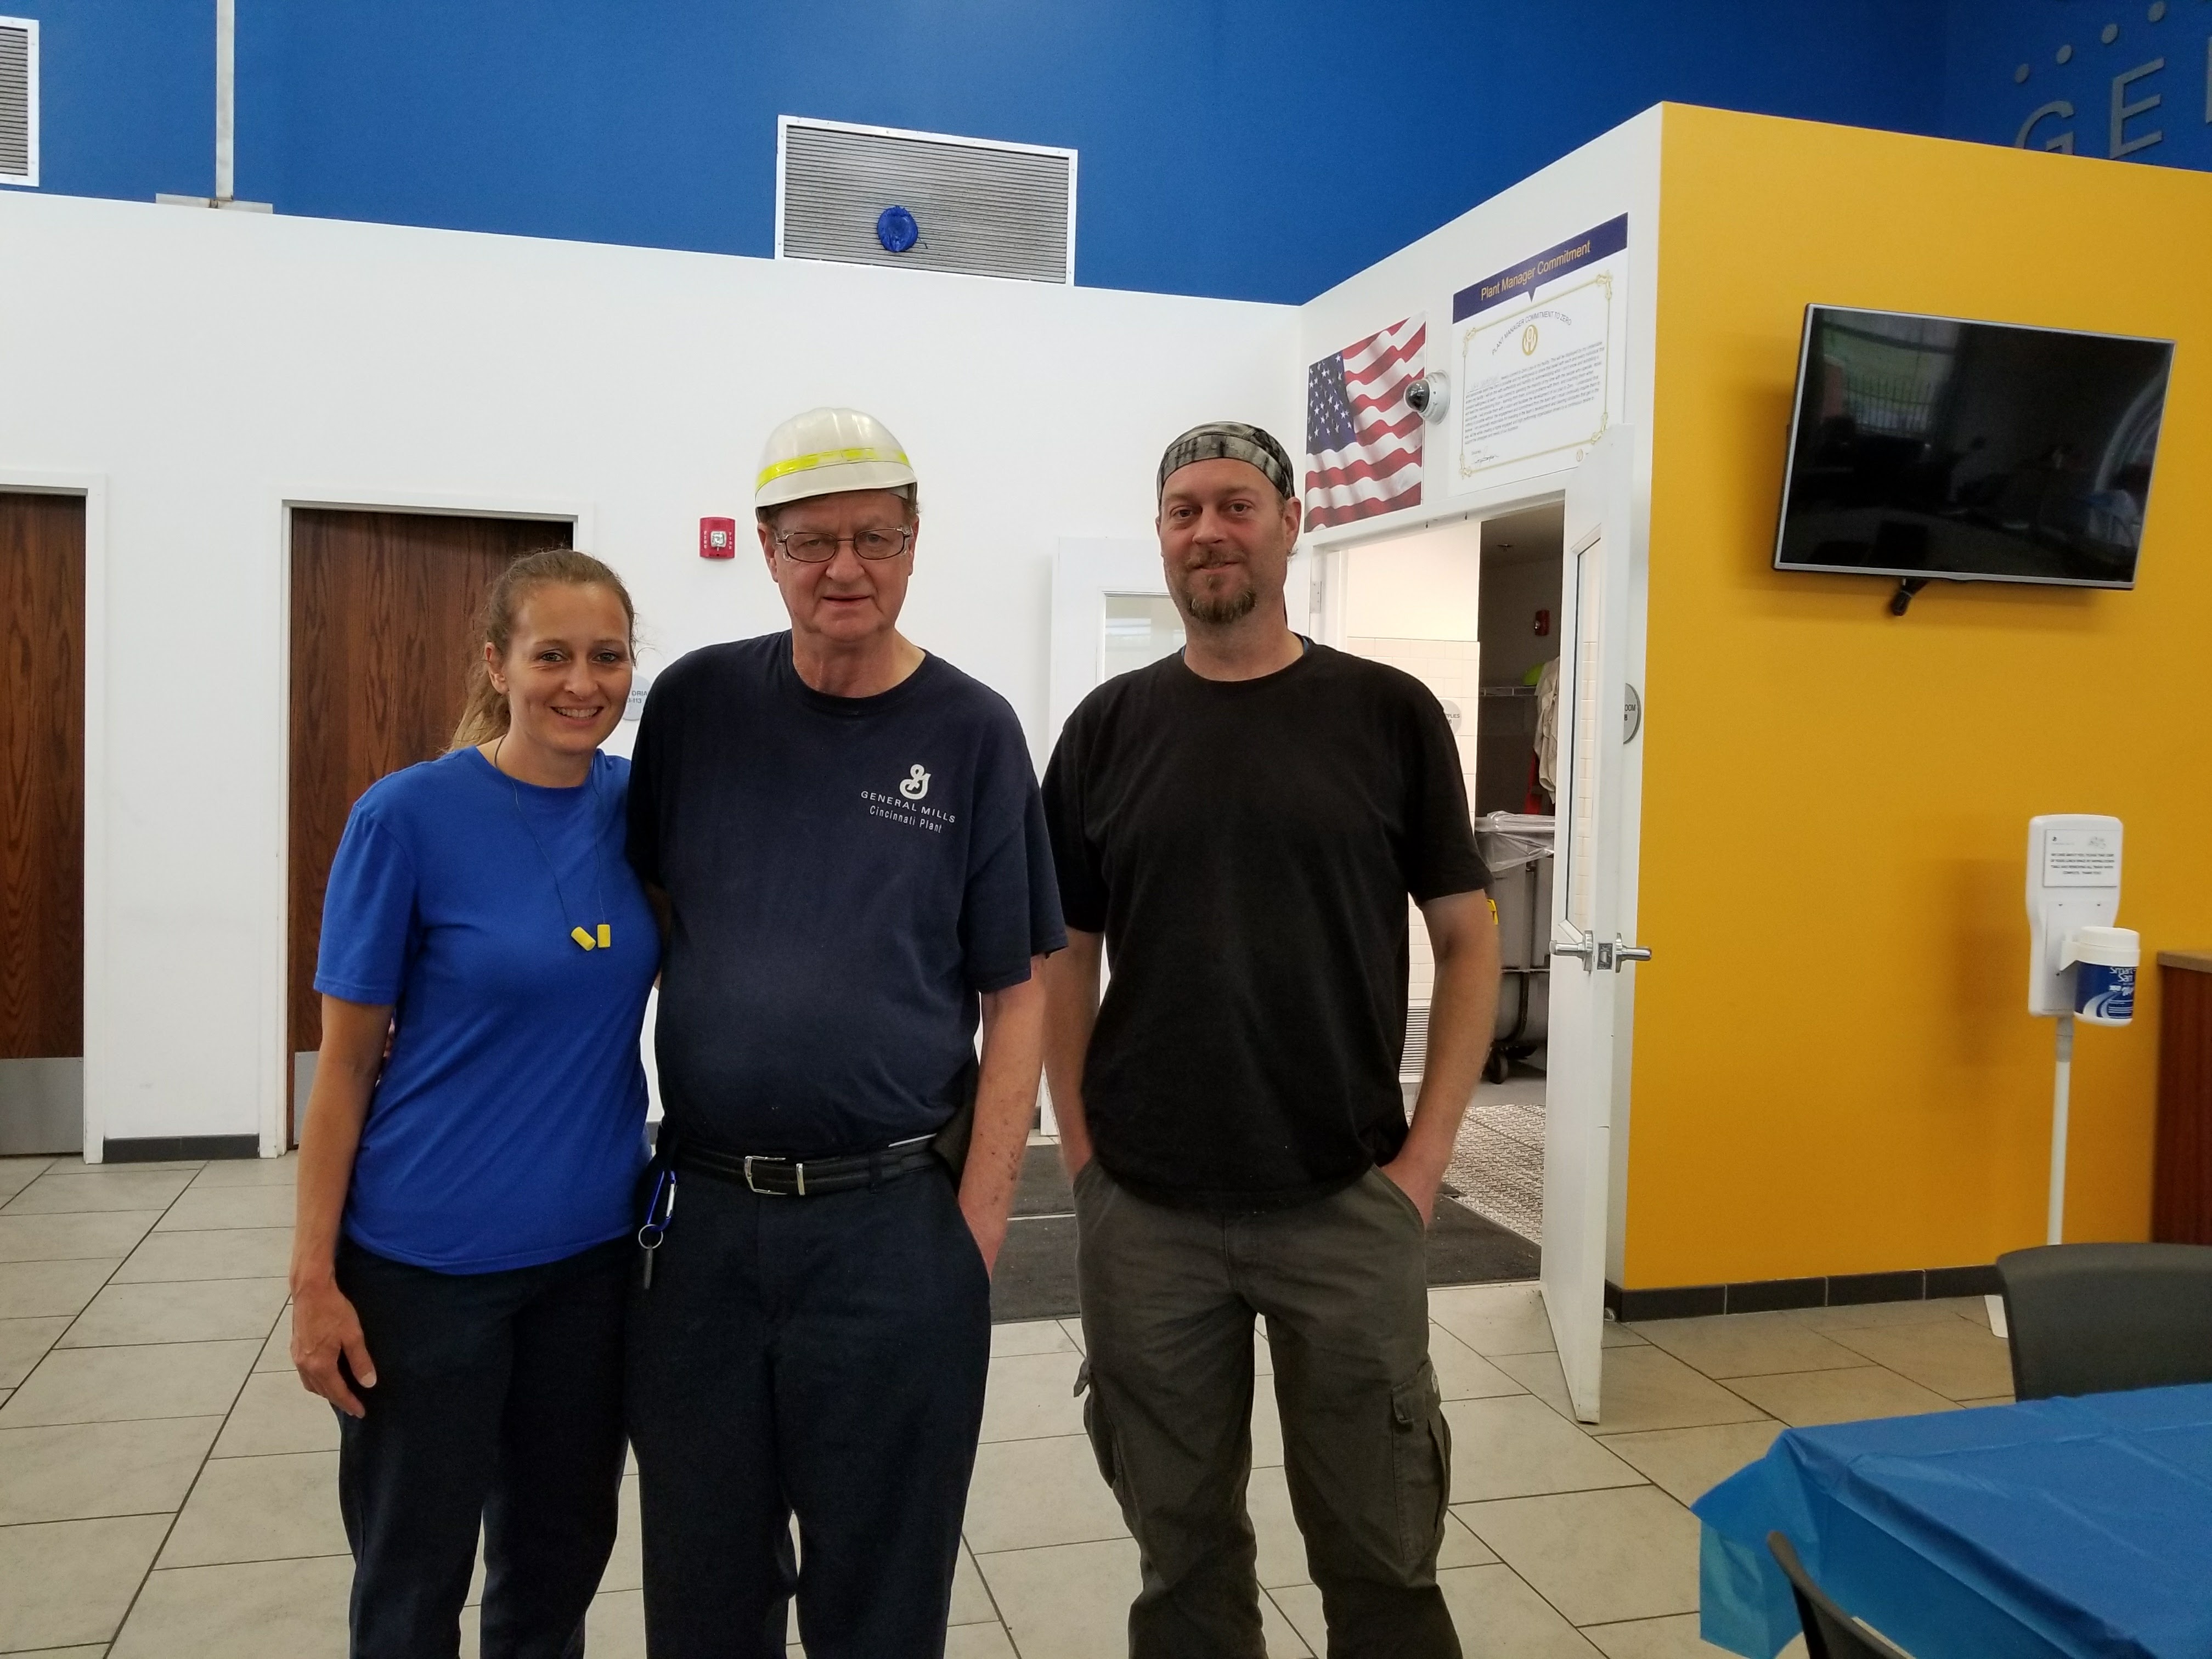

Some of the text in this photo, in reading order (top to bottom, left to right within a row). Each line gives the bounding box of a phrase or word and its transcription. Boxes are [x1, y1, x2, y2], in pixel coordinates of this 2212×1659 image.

[1481, 240, 1590, 301] Plant Manager Commitment
[1492, 311, 1572, 356] PLANT MANAGER COMMITMENT TO ZERO
[861, 791, 955, 823] GENERAL MILLS
[870, 805, 943, 833] Cincinnati Plant
